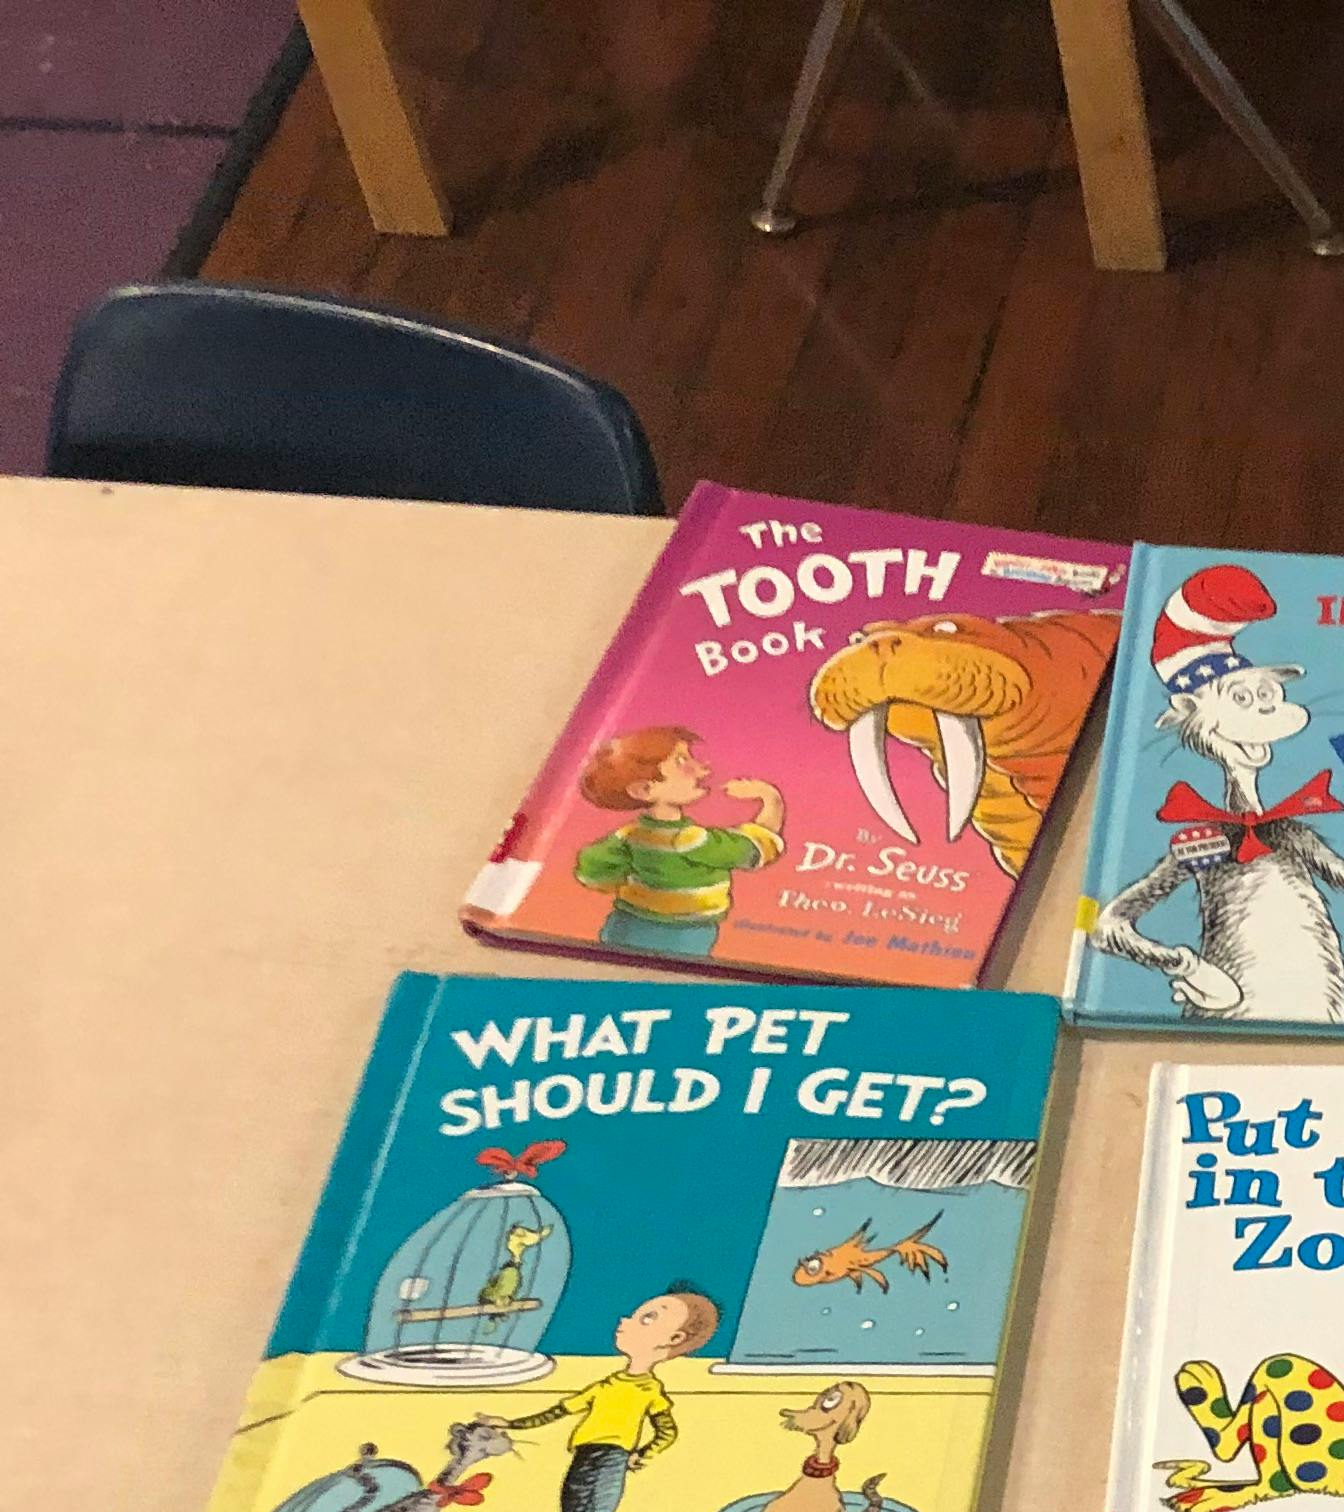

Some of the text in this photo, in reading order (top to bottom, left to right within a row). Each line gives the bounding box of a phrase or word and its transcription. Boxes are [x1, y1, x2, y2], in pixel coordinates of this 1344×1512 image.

[740, 520, 822, 548] The
[679, 548, 961, 628] TOOTH
[695, 621, 827, 676] Book
[795, 842, 969, 892] Dr. Seuss
[450, 1006, 851, 1070] WHAT PET
[437, 1066, 989, 1138] SHOULD I GET?
[1175, 1090, 1324, 1157] Put
[1185, 1152, 1283, 1210] in
